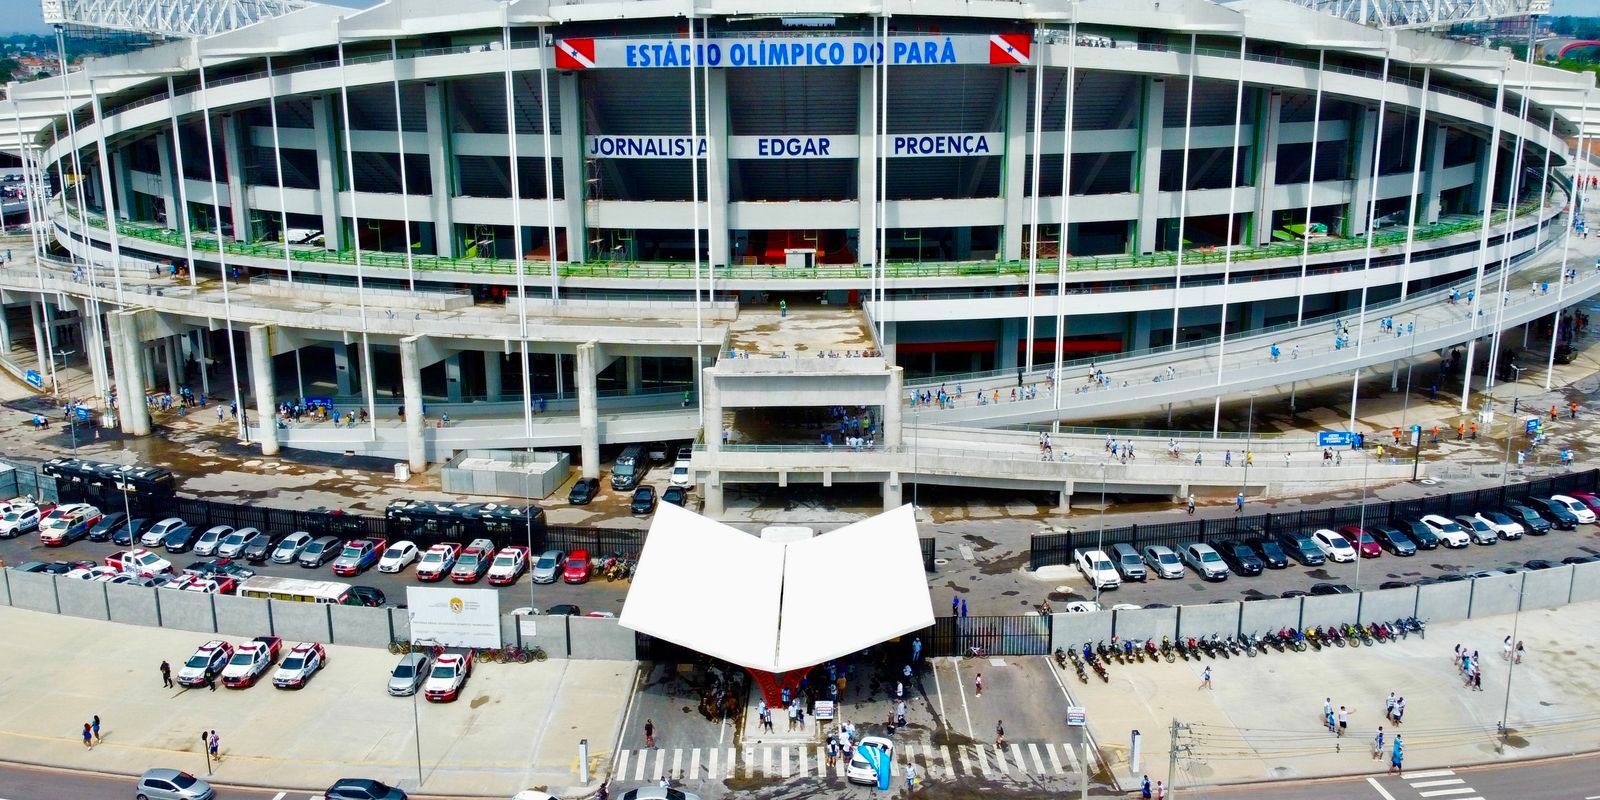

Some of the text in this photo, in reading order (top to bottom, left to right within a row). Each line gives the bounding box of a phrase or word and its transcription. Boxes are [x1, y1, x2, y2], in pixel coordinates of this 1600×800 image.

[626, 37, 957, 66] ESTÁDIO OLÍMPICO DO PARÁ
[758, 138, 830, 156] EDGAR
[894, 135, 989, 156] PROENÇA
